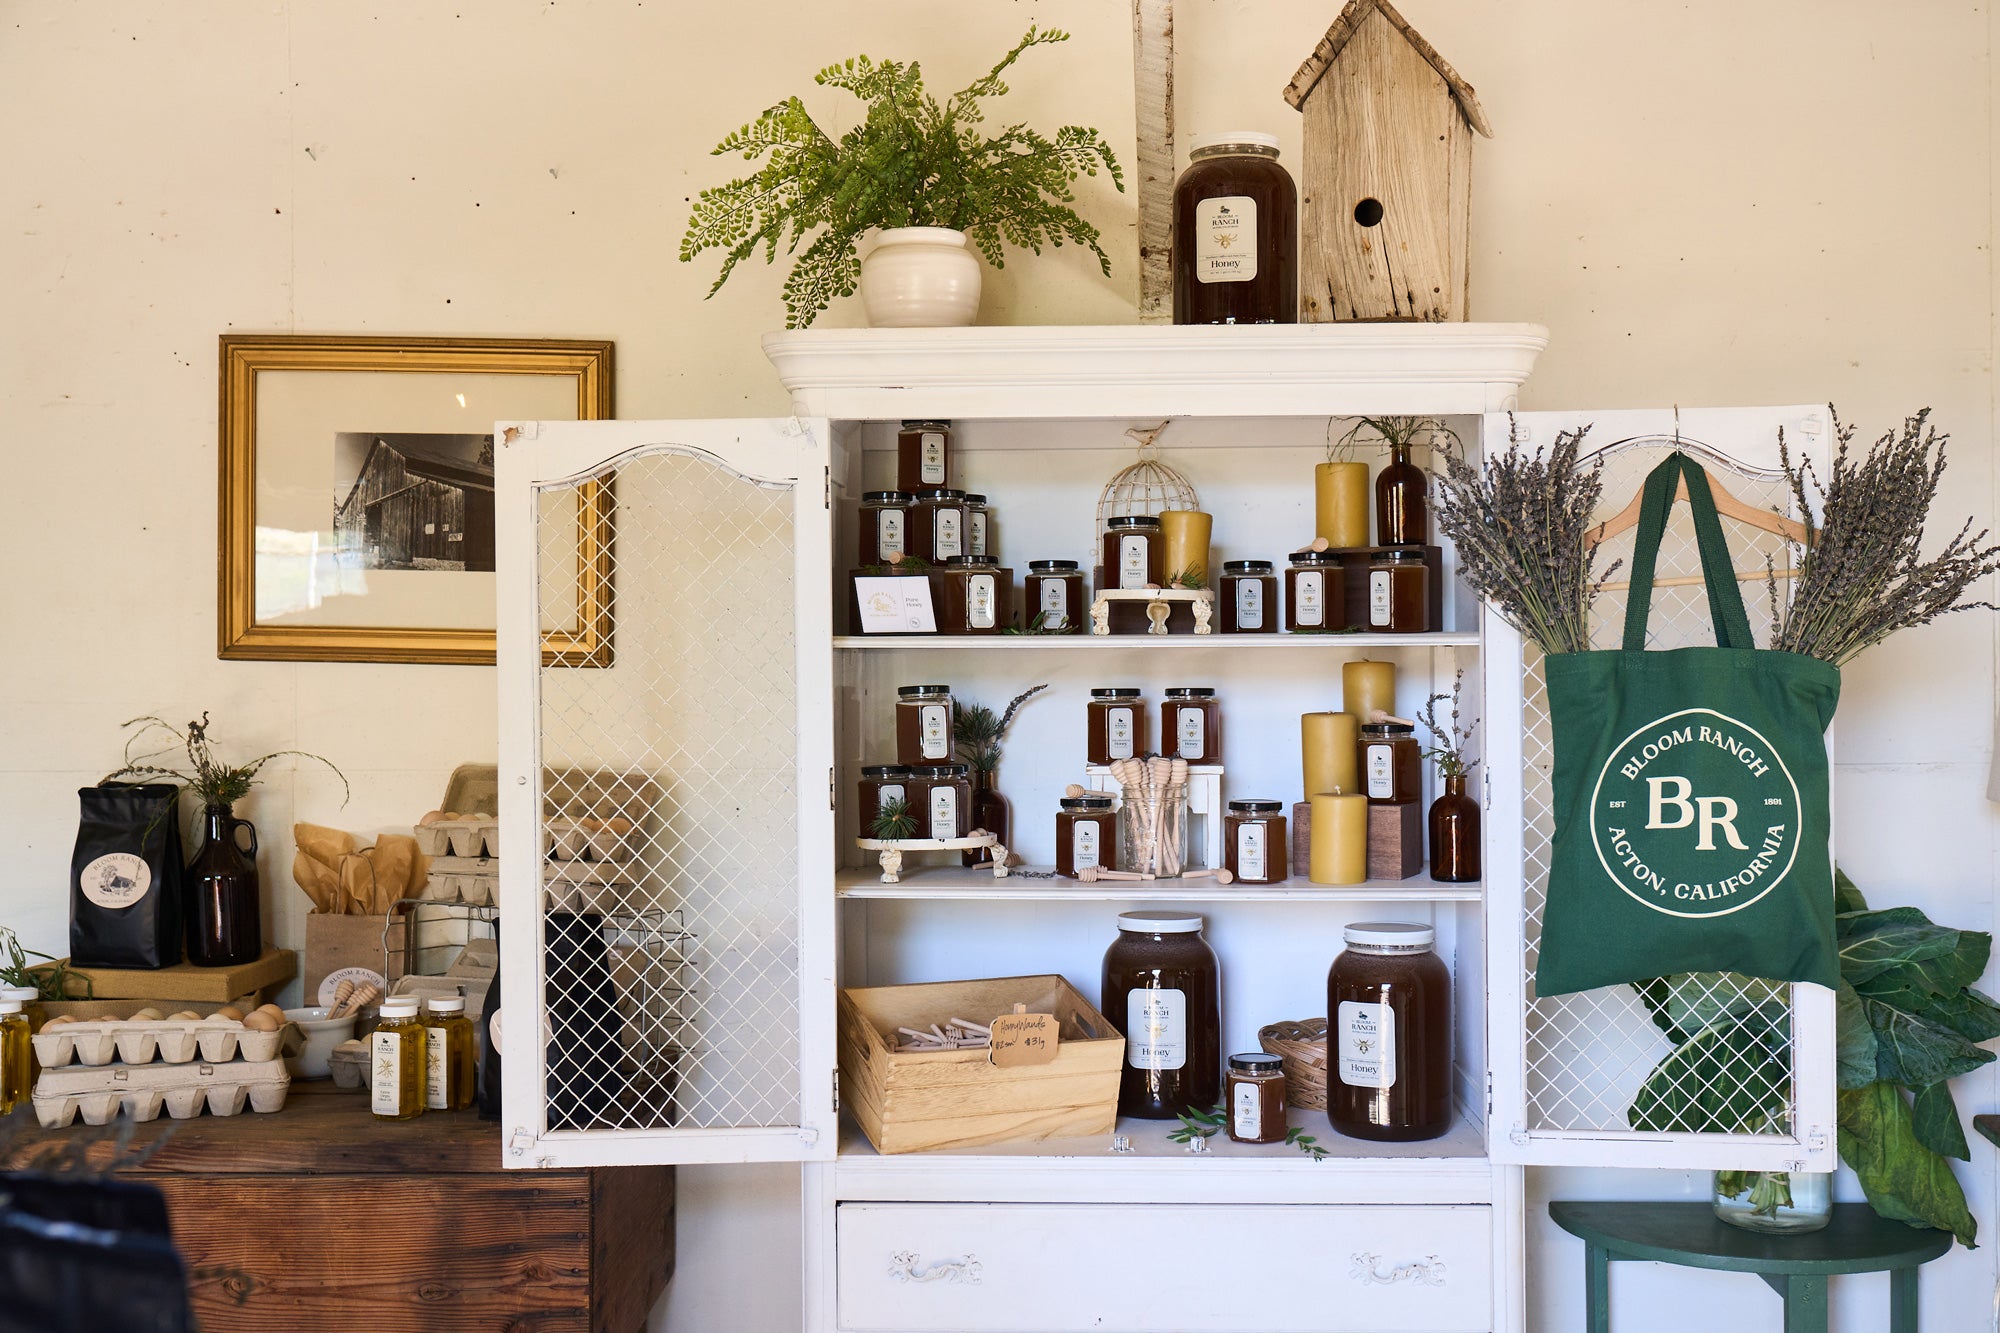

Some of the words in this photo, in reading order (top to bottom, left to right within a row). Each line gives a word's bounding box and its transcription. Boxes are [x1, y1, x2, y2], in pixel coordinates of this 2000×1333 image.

[1212, 218, 1239, 226] RANCH
[1211, 260, 1240, 269] Honey
[1620, 727, 1693, 781] BLOOM
[1699, 726, 1769, 778] RANCH
[1764, 798, 1783, 806] 1891
[1645, 776, 1749, 850] BR
[93, 856, 118, 871] BLOOM
[1609, 826, 1667, 896] ACTON,
[1674, 824, 1785, 900] CALIFORNIA
[329, 970, 353, 985] BLOOM
[356, 970, 380, 985] RANCH
[1351, 1064, 1378, 1074] Honey
